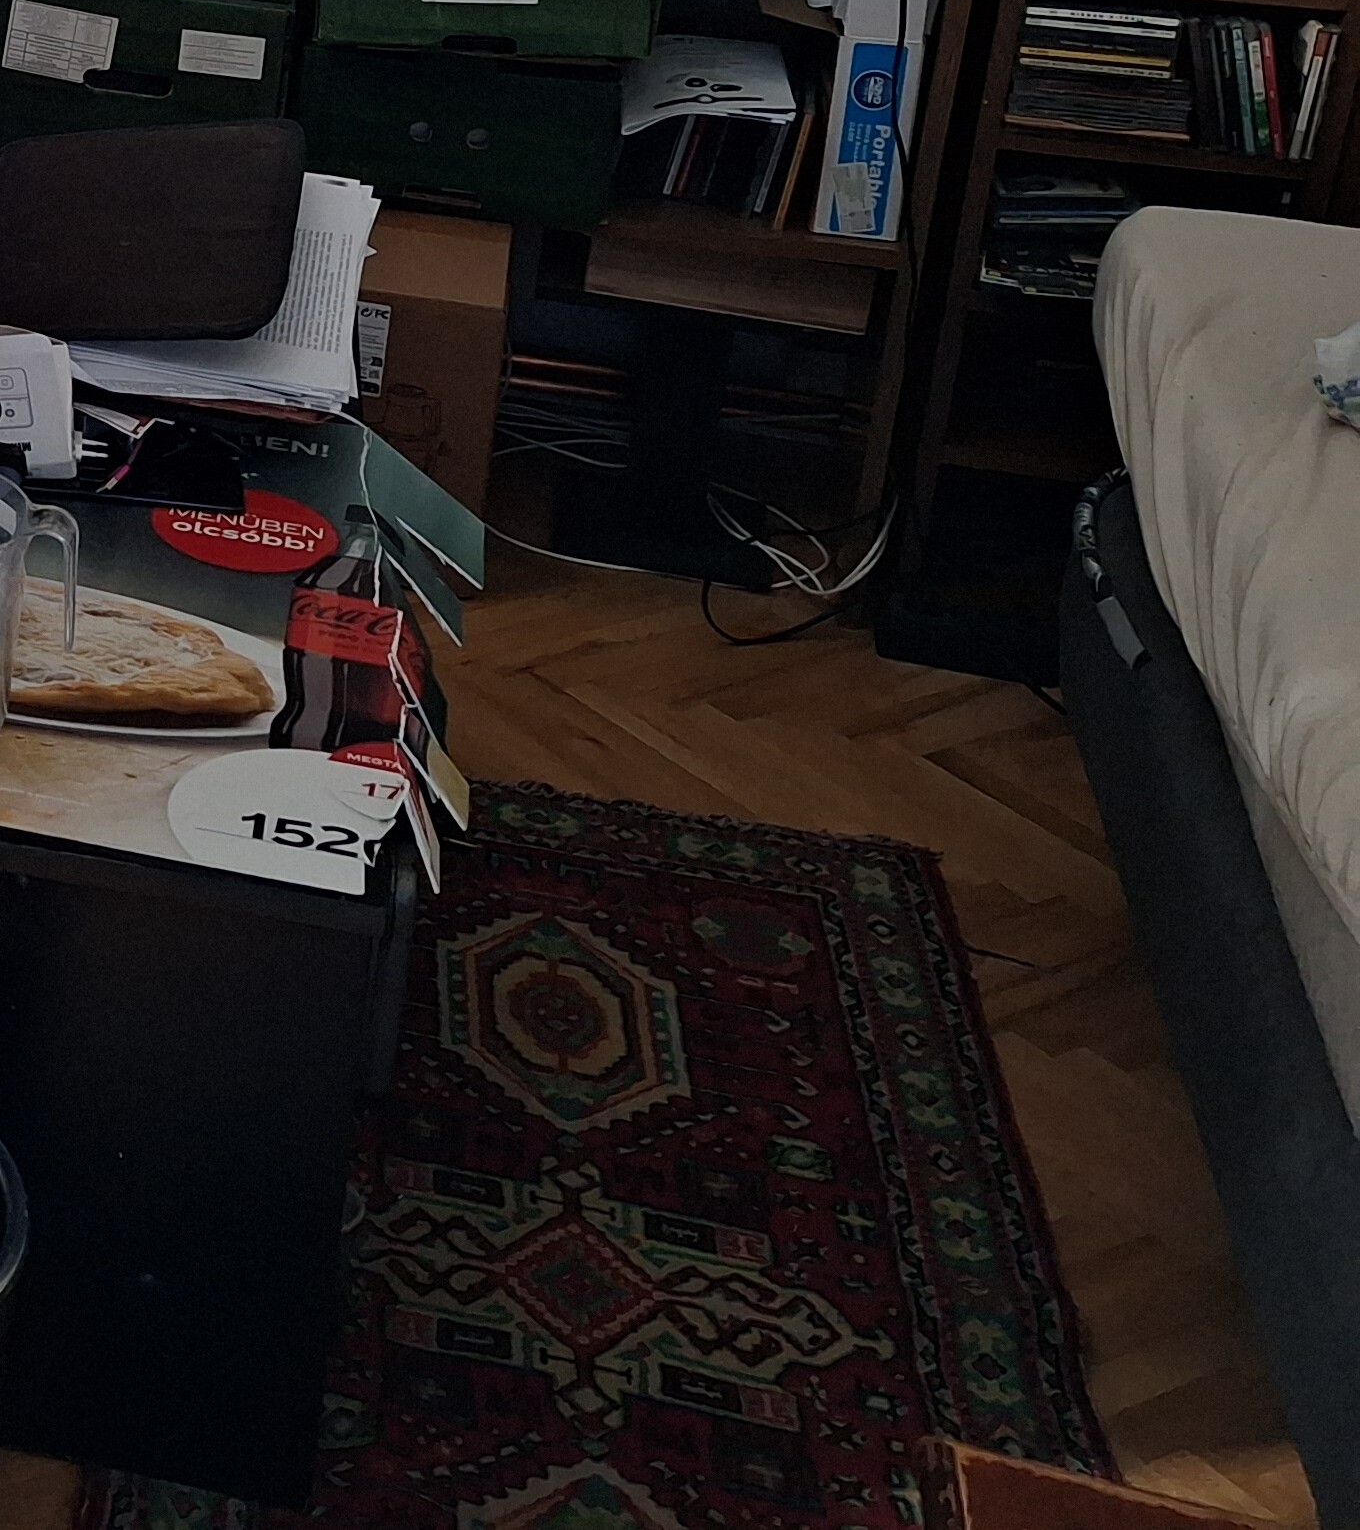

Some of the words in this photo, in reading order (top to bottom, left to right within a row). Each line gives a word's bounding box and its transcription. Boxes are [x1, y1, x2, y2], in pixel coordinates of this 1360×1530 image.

[169, 506, 325, 541] MENÜBEN
[172, 519, 315, 553] olcsóbb!
[346, 751, 404, 771] MEGTA
